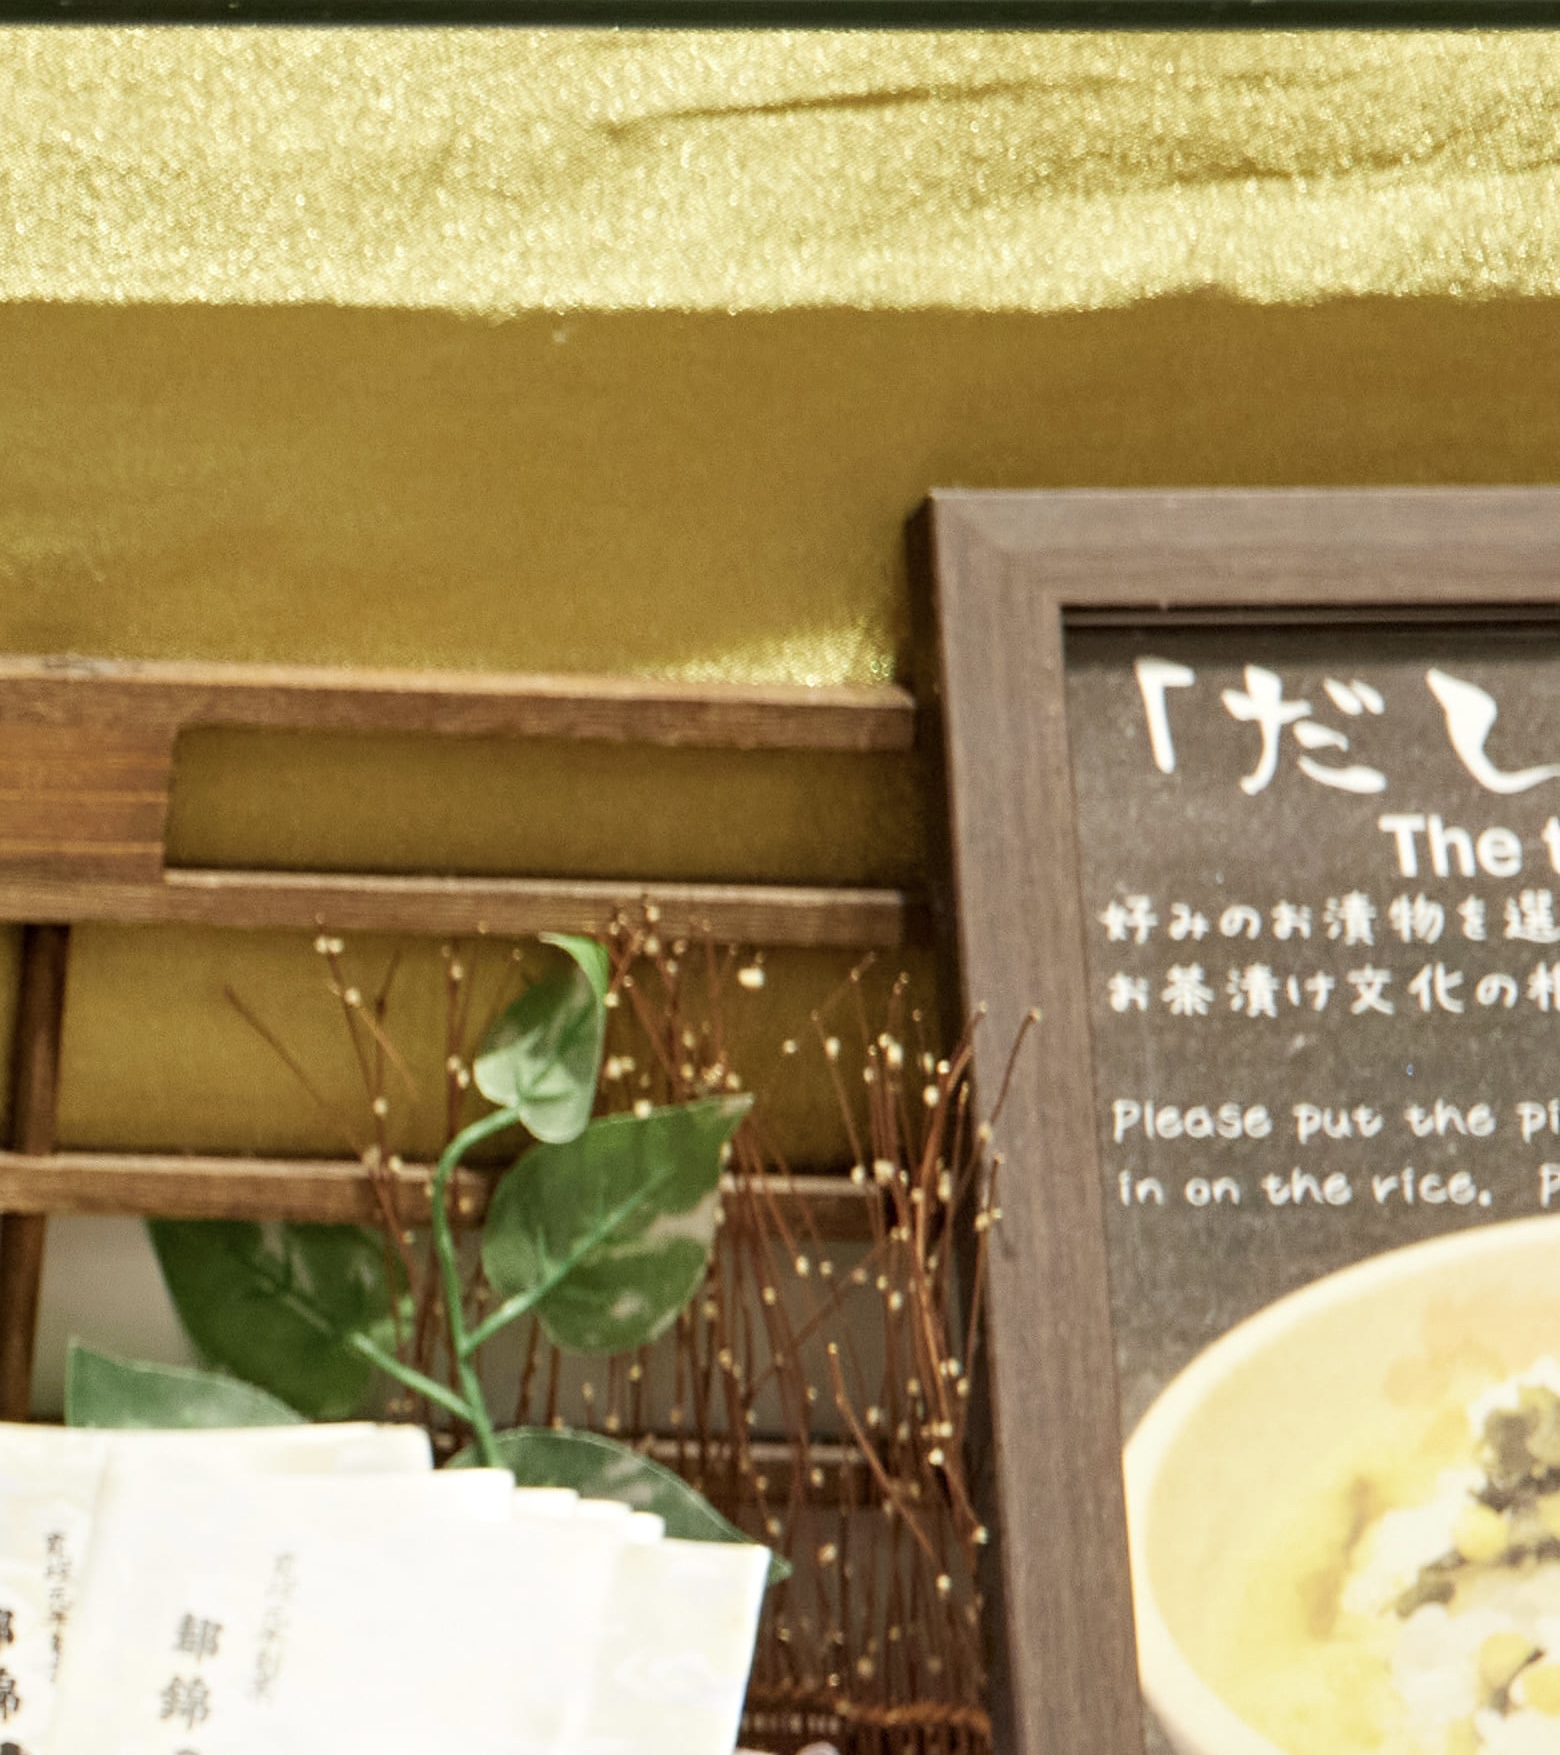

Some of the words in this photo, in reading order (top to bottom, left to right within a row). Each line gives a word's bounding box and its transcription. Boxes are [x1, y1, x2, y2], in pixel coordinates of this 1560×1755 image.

[1377, 814, 1522, 878] The
[1113, 1099, 1271, 1143] Please
[1292, 1103, 1382, 1143] put
[1405, 1101, 1497, 1139] the
[1119, 1169, 1163, 1206] in
[1183, 1175, 1241, 1208] on
[1261, 1169, 1353, 1208] the
[1372, 1170, 1492, 1208] rice.
